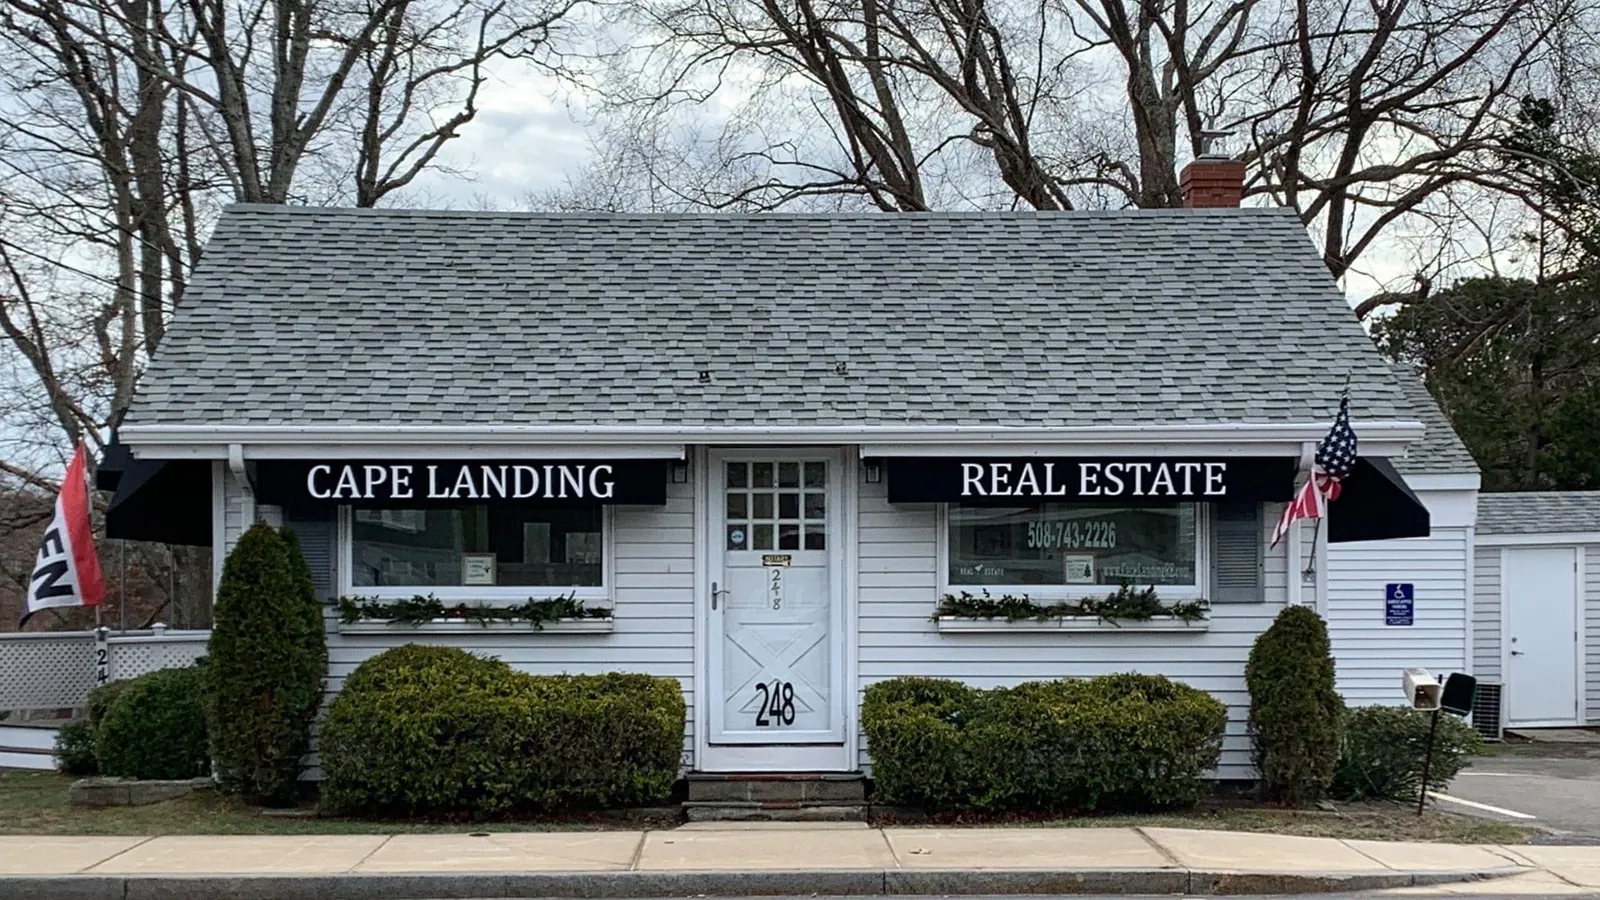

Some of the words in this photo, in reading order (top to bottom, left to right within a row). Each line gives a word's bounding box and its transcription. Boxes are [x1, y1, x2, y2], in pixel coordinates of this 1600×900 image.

[307, 464, 413, 499] CAPE
[426, 464, 615, 499] LANDING
[960, 462, 1066, 496] REAL
[1078, 462, 1227, 496] ESTATE
[1027, 520, 1117, 549] 508-743-2226
[32, 527, 74, 601] EN
[97, 649, 109, 685] 24
[755, 682, 796, 727] 248
